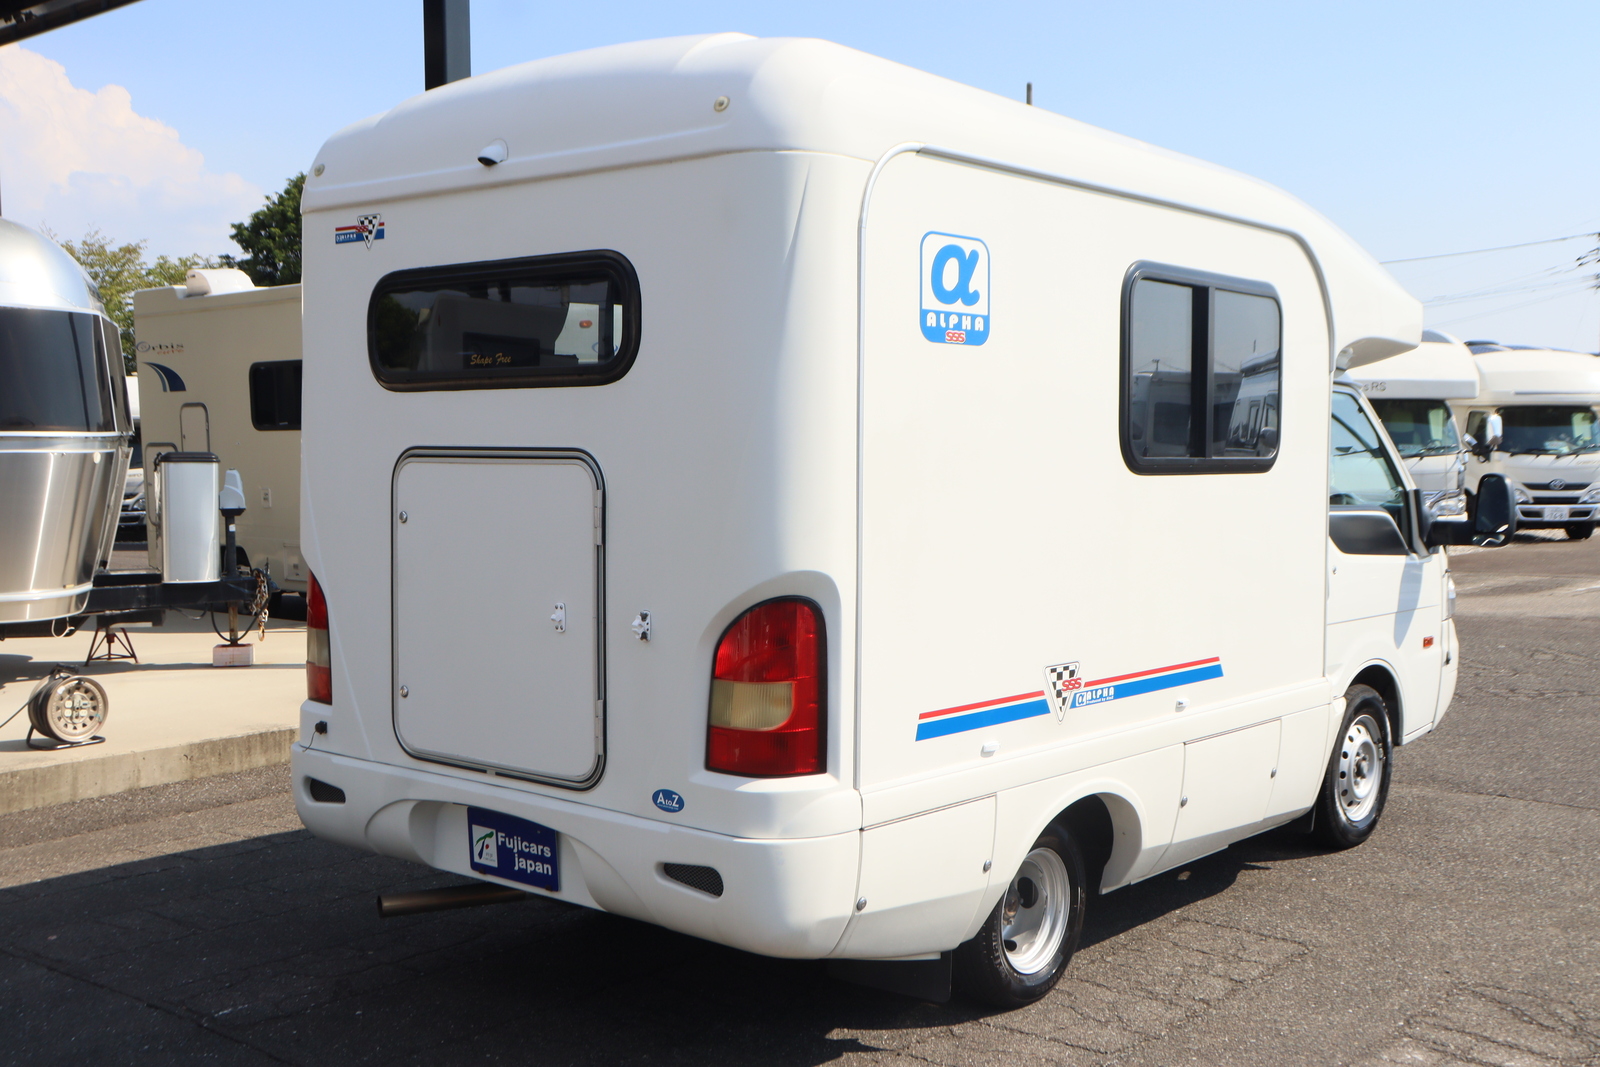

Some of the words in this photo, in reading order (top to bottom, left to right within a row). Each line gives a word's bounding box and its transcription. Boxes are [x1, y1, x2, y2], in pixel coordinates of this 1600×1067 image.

[926, 311, 984, 332] ALPHA
[945, 330, 966, 343] SSS
[470, 354, 493, 366] Shape
[495, 352, 512, 365] Free
[1061, 677, 1082, 692] SSS
[1086, 686, 1114, 701] ALPHA
[497, 831, 552, 858] Fujicars
[514, 853, 552, 876] japan
